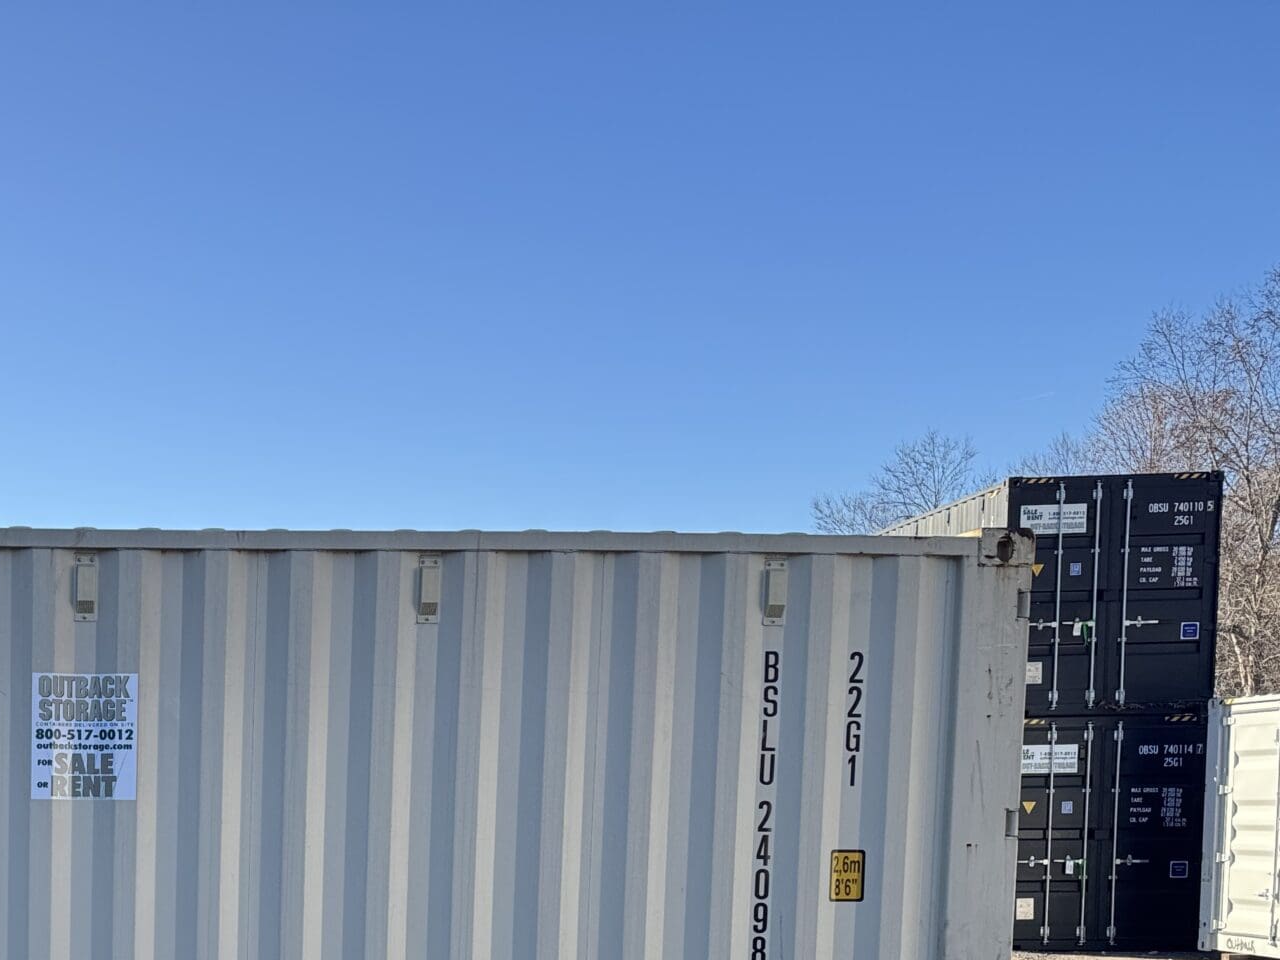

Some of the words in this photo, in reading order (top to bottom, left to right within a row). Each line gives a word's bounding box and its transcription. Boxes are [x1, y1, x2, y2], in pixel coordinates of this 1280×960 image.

[1174, 501, 1204, 512] 740110
[1207, 501, 1215, 511] 5
[1174, 515, 1193, 525] 25G1
[38, 675, 131, 699] OUTBACK
[38, 698, 128, 722] STORAGE
[759, 651, 780, 786] BSLU
[845, 651, 865, 787] 22G1
[35, 728, 134, 740] 800-517-0012
[36, 741, 133, 752] outbackstorage.com
[1163, 744, 1193, 755] 740114
[37, 759, 53, 767] FOR
[54, 753, 114, 775] SALE
[1163, 757, 1183, 767] 25G1
[51, 775, 118, 798] RENT
[833, 855, 861, 876] 2,6m
[834, 878, 858, 897] 8'6"
